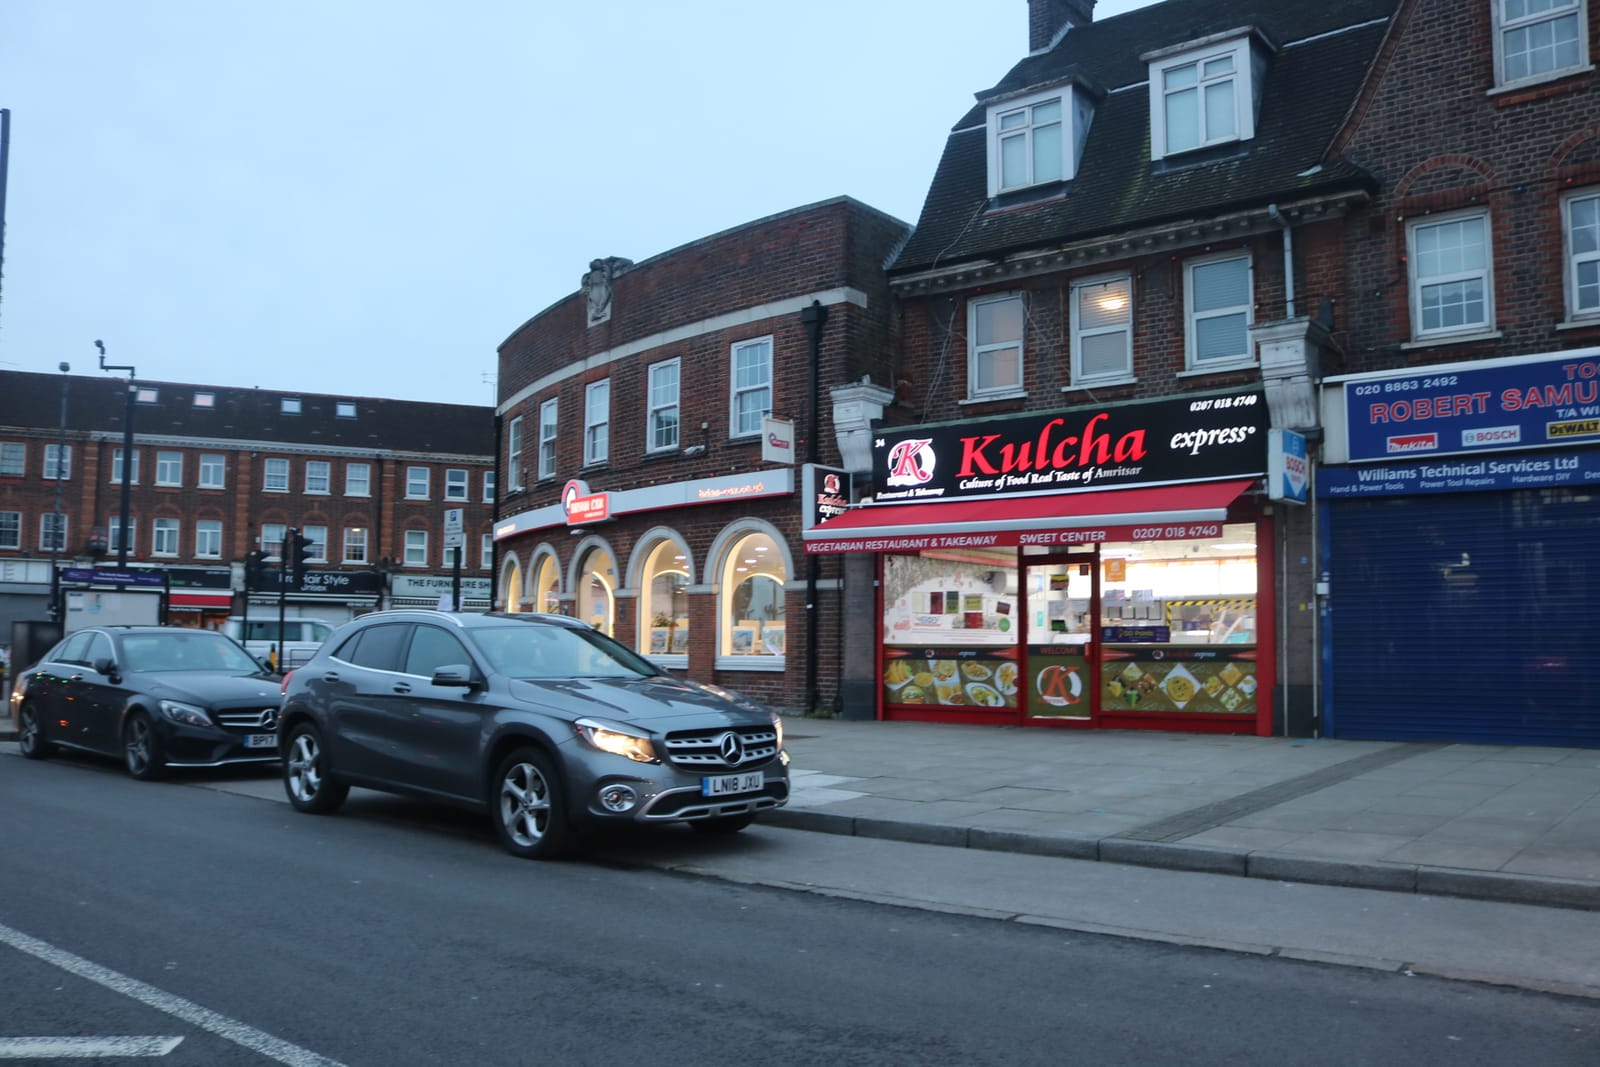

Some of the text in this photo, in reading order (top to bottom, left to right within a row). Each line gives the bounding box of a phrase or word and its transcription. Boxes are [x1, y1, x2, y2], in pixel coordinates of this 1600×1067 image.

[1562, 362, 1600, 380] TO
[1355, 376, 1458, 395] 020 8863 2492
[1190, 395, 1257, 411] 0207 018 4740
[1370, 391, 1491, 424] ROBERT
[1556, 408, 1577, 418] T/A
[1476, 429, 1517, 442] BOSCH
[955, 413, 1148, 478] Kulcha
[1358, 456, 1579, 482] Williams Technical Services Ltd
[959, 465, 1142, 491] Culture of Food Real Taste of Amritsar
[1420, 477, 1496, 489] Power Tool Repairs
[1512, 472, 1571, 484] Hardware DIY
[1330, 482, 1404, 494] Hand & Power Tools
[1019, 531, 1107, 544] SWEET CENTER
[1132, 525, 1218, 539] 0207 018 4740
[806, 535, 998, 552] VEGETARIAN RESTAURANT & TAKEAWAY
[323, 575, 349, 586] Style
[408, 579, 425, 588] THE
[713, 775, 760, 792] LN18 JXU
